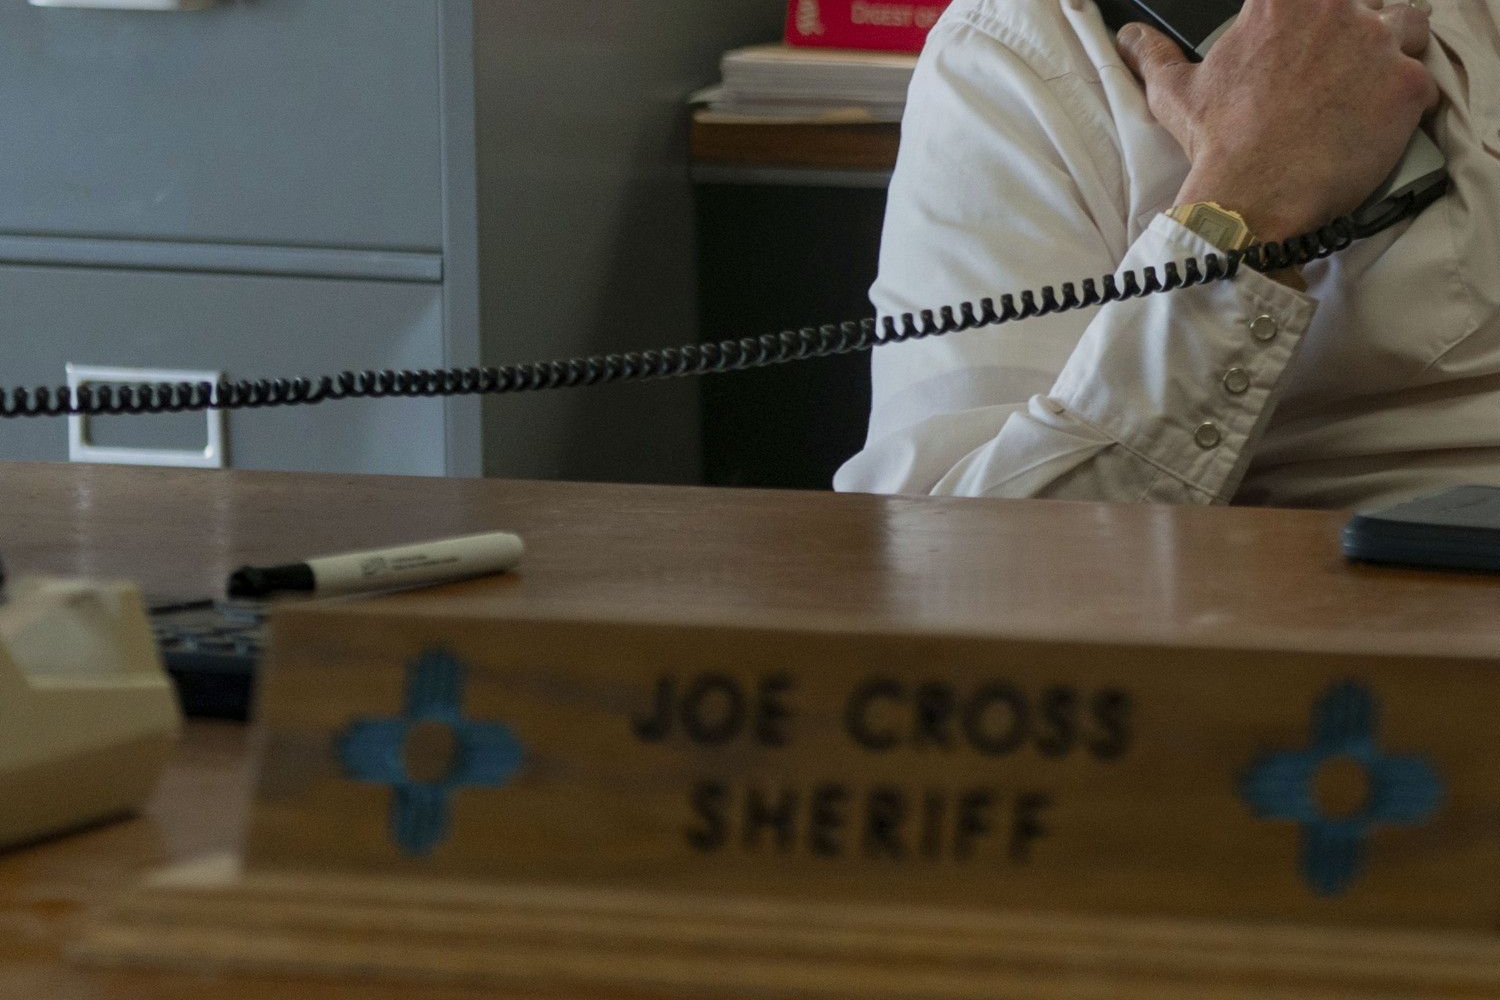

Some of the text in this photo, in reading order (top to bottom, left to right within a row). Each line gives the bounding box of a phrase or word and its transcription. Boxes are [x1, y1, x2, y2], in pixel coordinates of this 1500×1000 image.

[631, 671, 1134, 761] JOE CROSS
[685, 779, 1053, 866] SHERIFF
